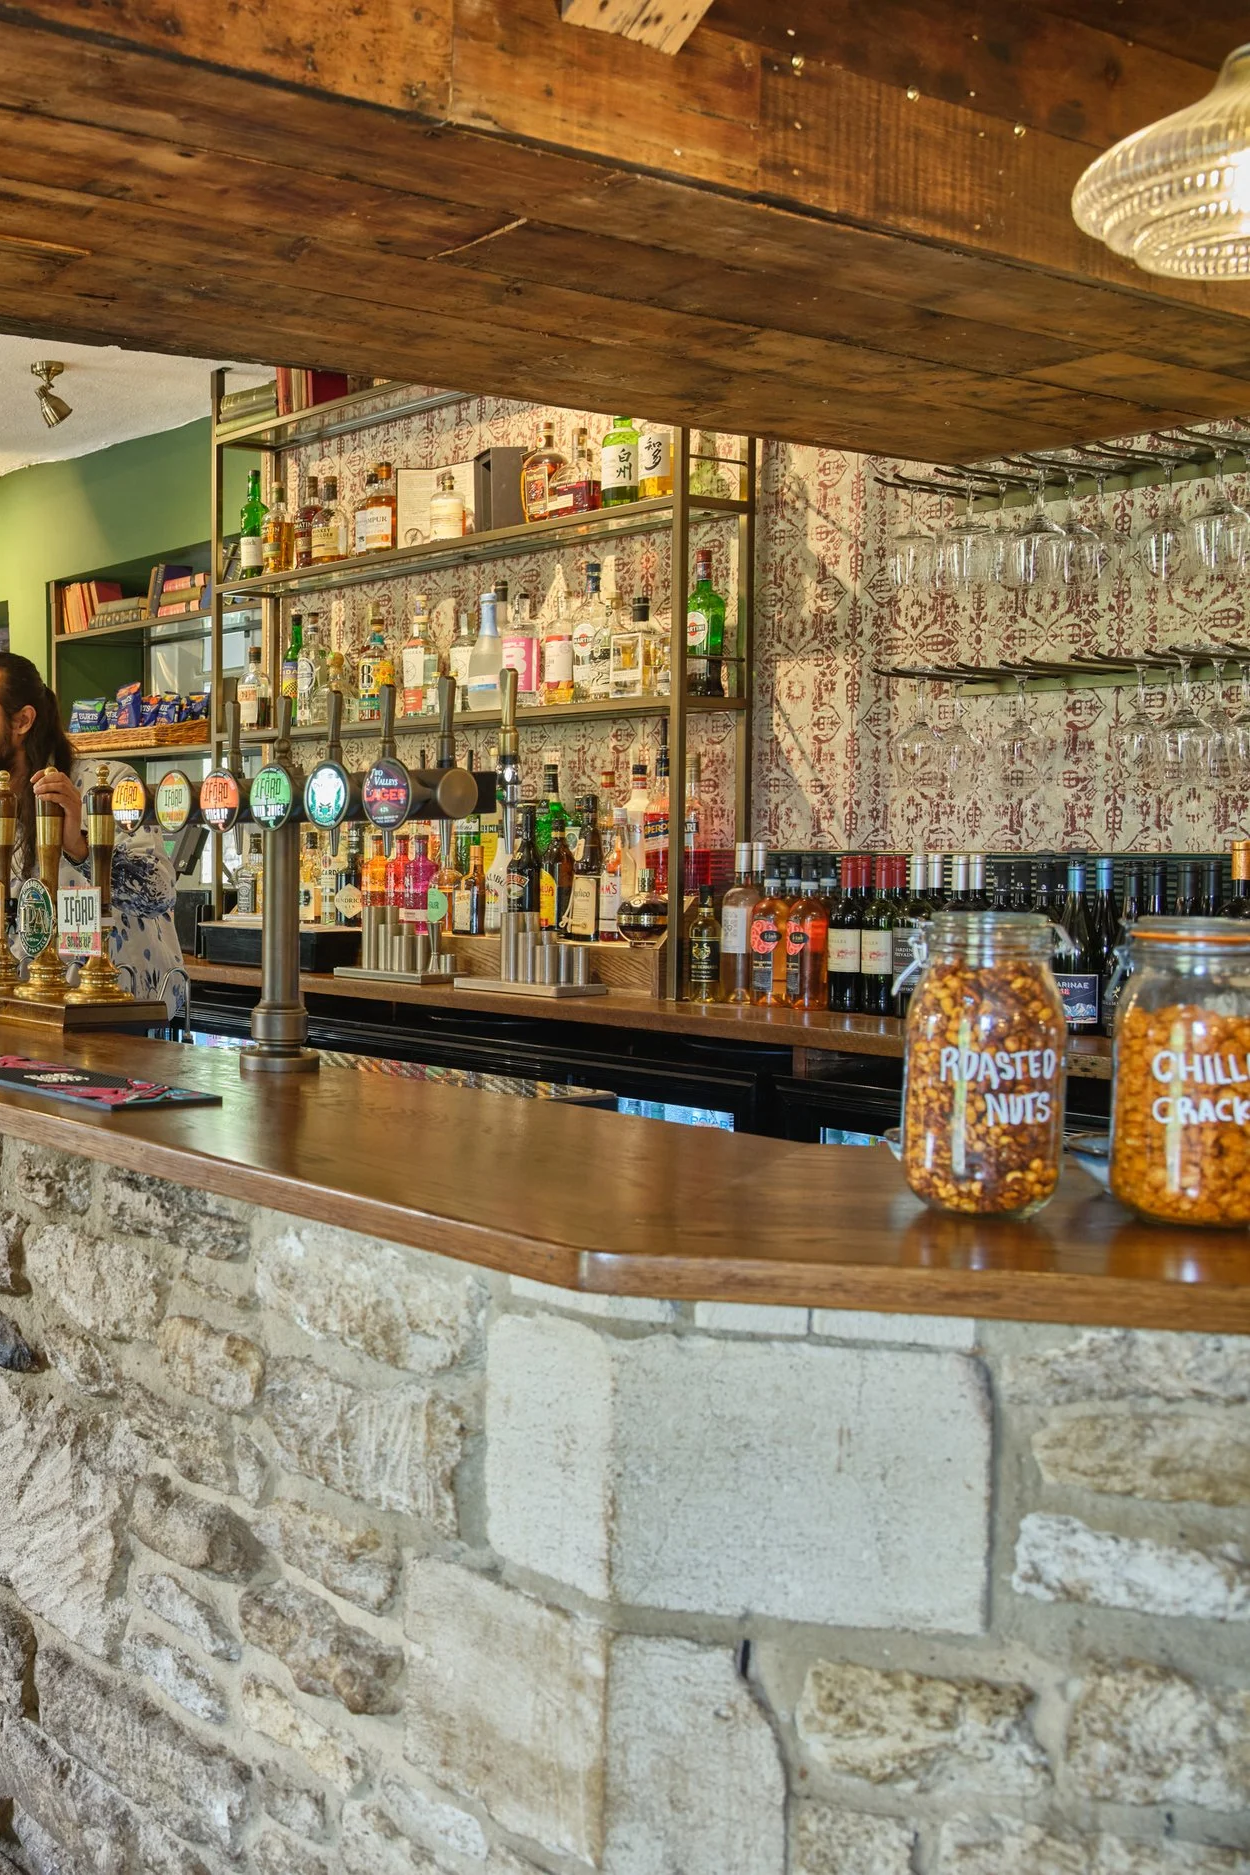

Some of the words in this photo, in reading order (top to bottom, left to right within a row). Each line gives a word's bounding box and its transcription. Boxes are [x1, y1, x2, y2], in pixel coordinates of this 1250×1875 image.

[616, 448, 632, 480] 白州
[644, 823, 668, 834] APERO
[64, 895, 94, 926] IFORD
[1056, 981, 1090, 989] ARINAE
[939, 1046, 1057, 1090] ROASTED
[984, 1092, 1051, 1127] NUTS
[1152, 1096, 1250, 1126] CRACK
